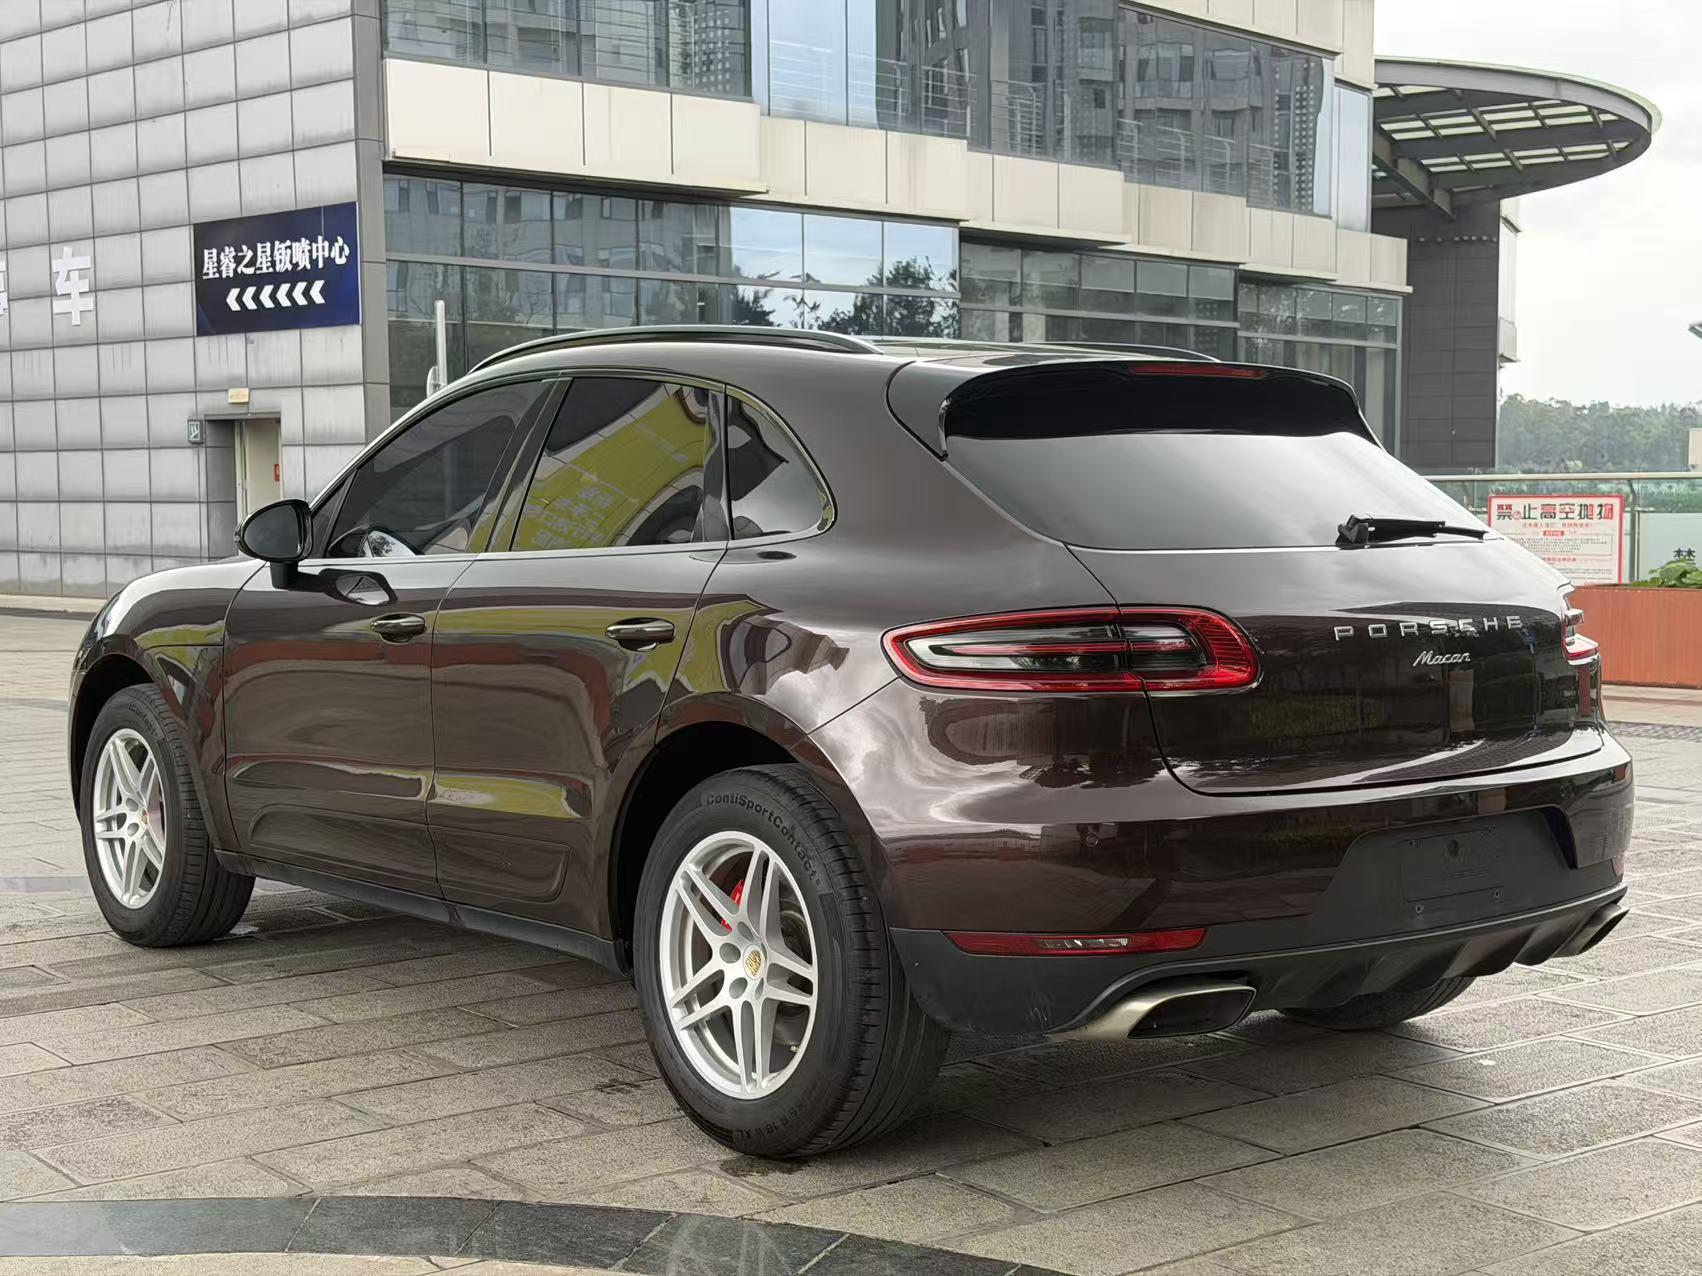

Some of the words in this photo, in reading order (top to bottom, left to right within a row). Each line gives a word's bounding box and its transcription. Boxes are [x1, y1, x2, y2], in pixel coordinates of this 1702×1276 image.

[202, 235, 350, 279] 星睿之星钣喷中心
[1496, 503, 1615, 521] 禁止高空抛物
[1333, 615, 1523, 641] PORSCHE
[1412, 650, 1471, 667] Macan
[706, 792, 817, 881] ContiSportContact
